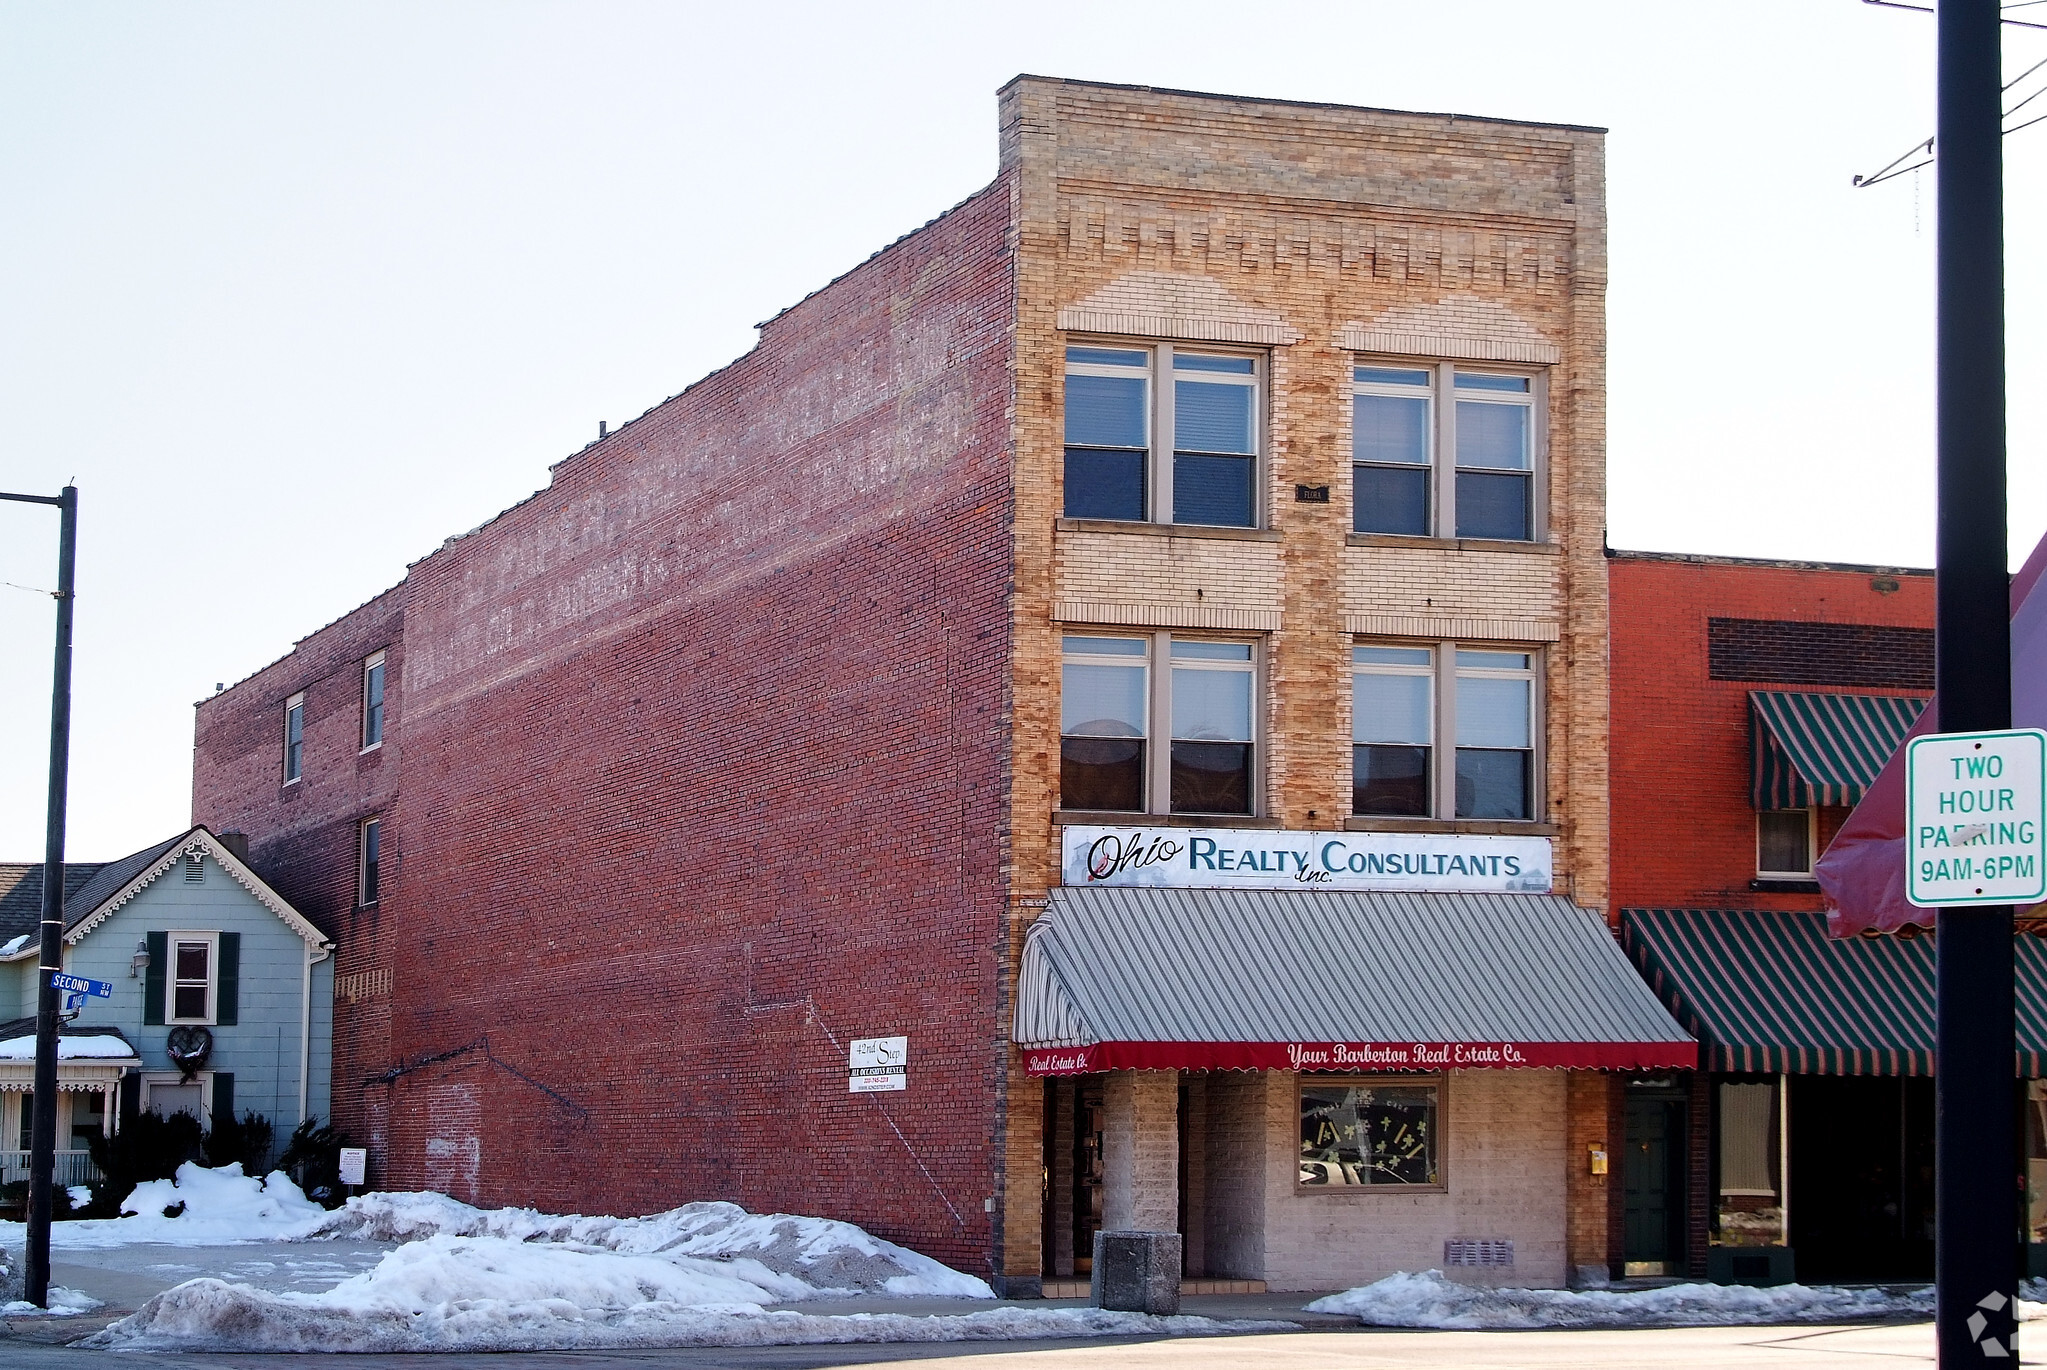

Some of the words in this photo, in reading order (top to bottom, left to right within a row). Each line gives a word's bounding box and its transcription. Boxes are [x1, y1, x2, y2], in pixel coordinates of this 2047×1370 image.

[1950, 755, 2003, 780] TWO
[1939, 788, 2015, 814] HOUR
[1087, 832, 1184, 879] Ohio
[1189, 837, 1308, 872] REALTY
[1321, 840, 1521, 876] CONSULTANTS
[1294, 863, 1333, 883] Inc.
[1921, 855, 2034, 882] 9AM-6PM
[856, 1041, 877, 1055] 42nd
[876, 1041, 901, 1065] Step
[1028, 1055, 1050, 1072] Real
[1050, 1054, 1075, 1071] Estate
[1076, 1052, 1088, 1069] Co.
[1287, 1043, 1329, 1069] Your
[1333, 1043, 1409, 1063] Barberton
[1413, 1044, 1451, 1064] Real
[1454, 1043, 1501, 1063] Estate
[1502, 1043, 1527, 1063] Co.
[850, 1068, 860, 1076] ALL
[885, 1065, 905, 1075] RENTAL
